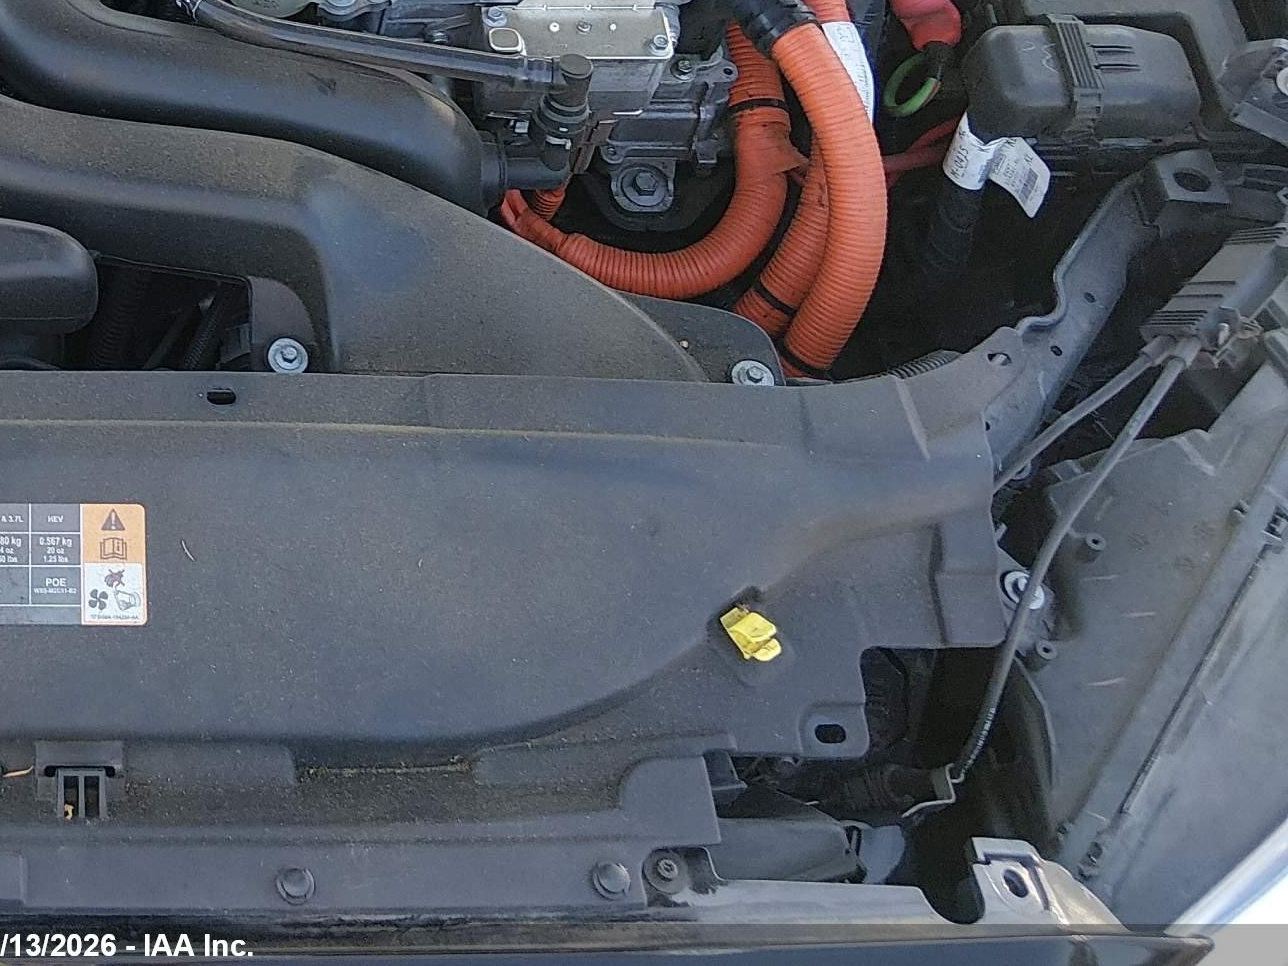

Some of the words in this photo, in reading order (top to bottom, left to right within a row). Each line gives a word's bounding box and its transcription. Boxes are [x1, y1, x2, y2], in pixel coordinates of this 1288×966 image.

[47, 515, 64, 523] HEV
[11, 536, 22, 547] kg
[62, 537, 73, 548] kg
[7, 555, 18, 563] lbs
[58, 555, 69, 563] lbs
[45, 577, 67, 587] POE
